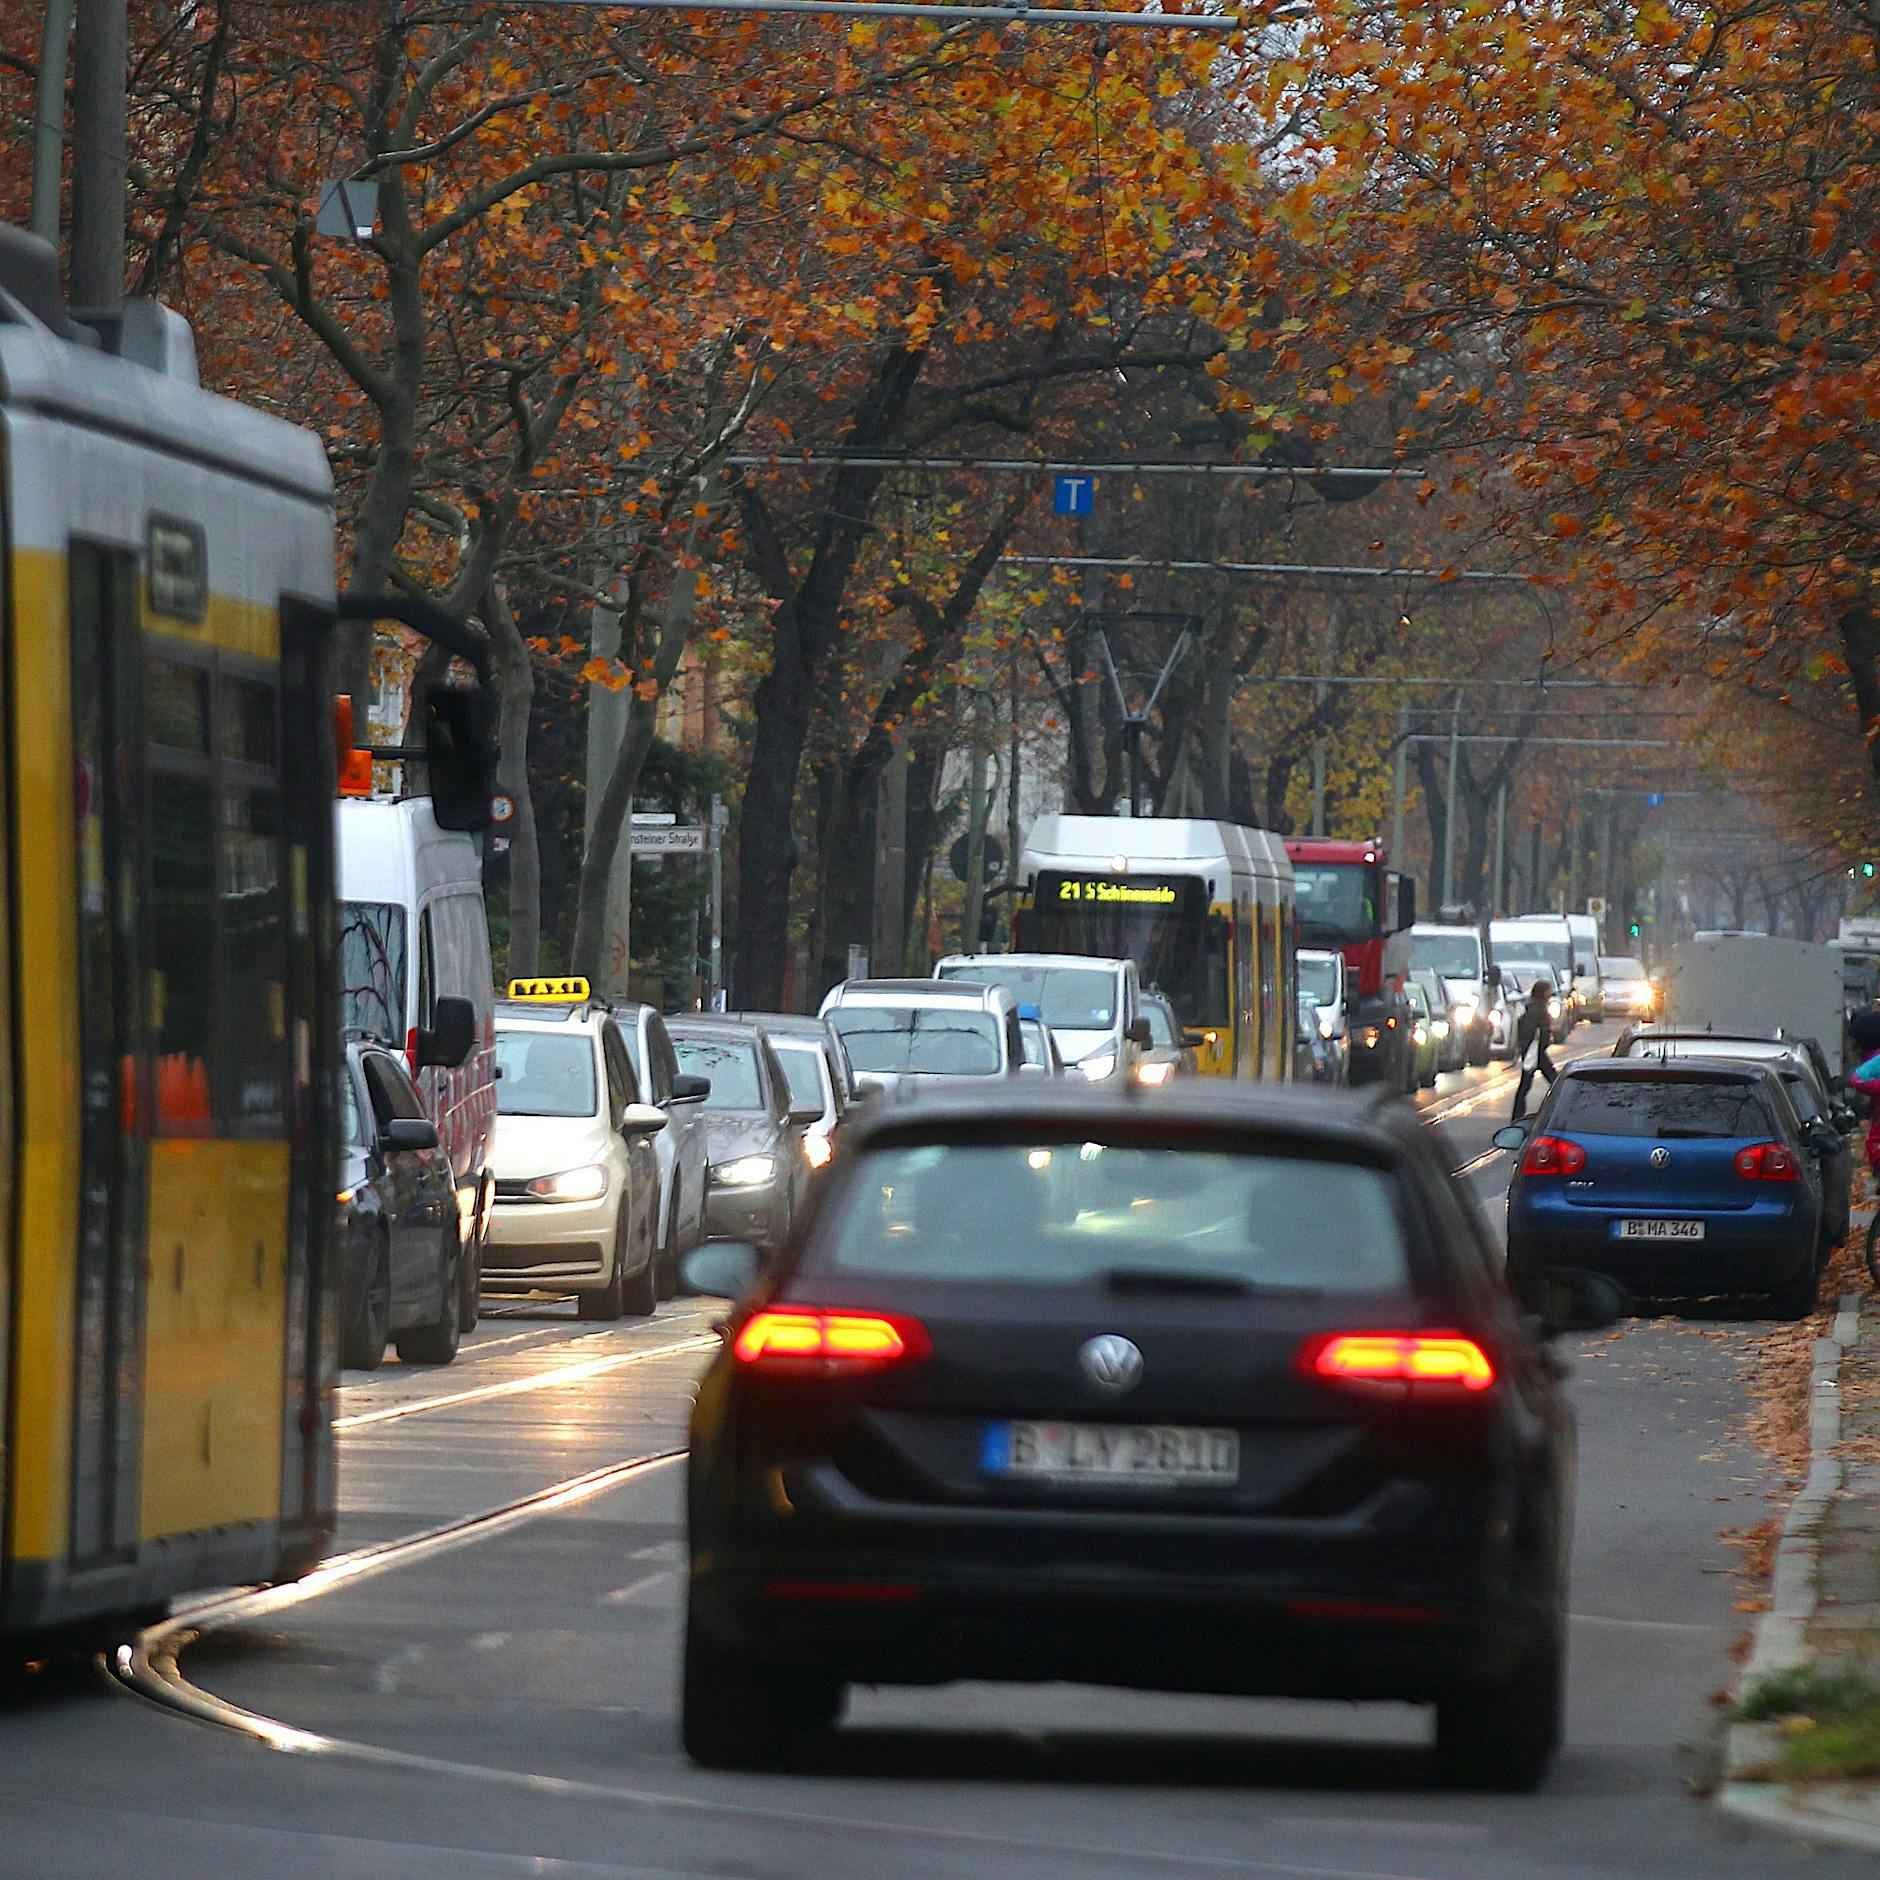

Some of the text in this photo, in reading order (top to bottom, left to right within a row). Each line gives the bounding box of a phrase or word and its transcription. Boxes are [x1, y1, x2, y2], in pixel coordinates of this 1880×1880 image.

[1064, 479, 1086, 510] T
[1060, 880, 1081, 900] 21
[521, 980, 577, 995] TAXI
[1626, 1221, 1699, 1237] B MA 346
